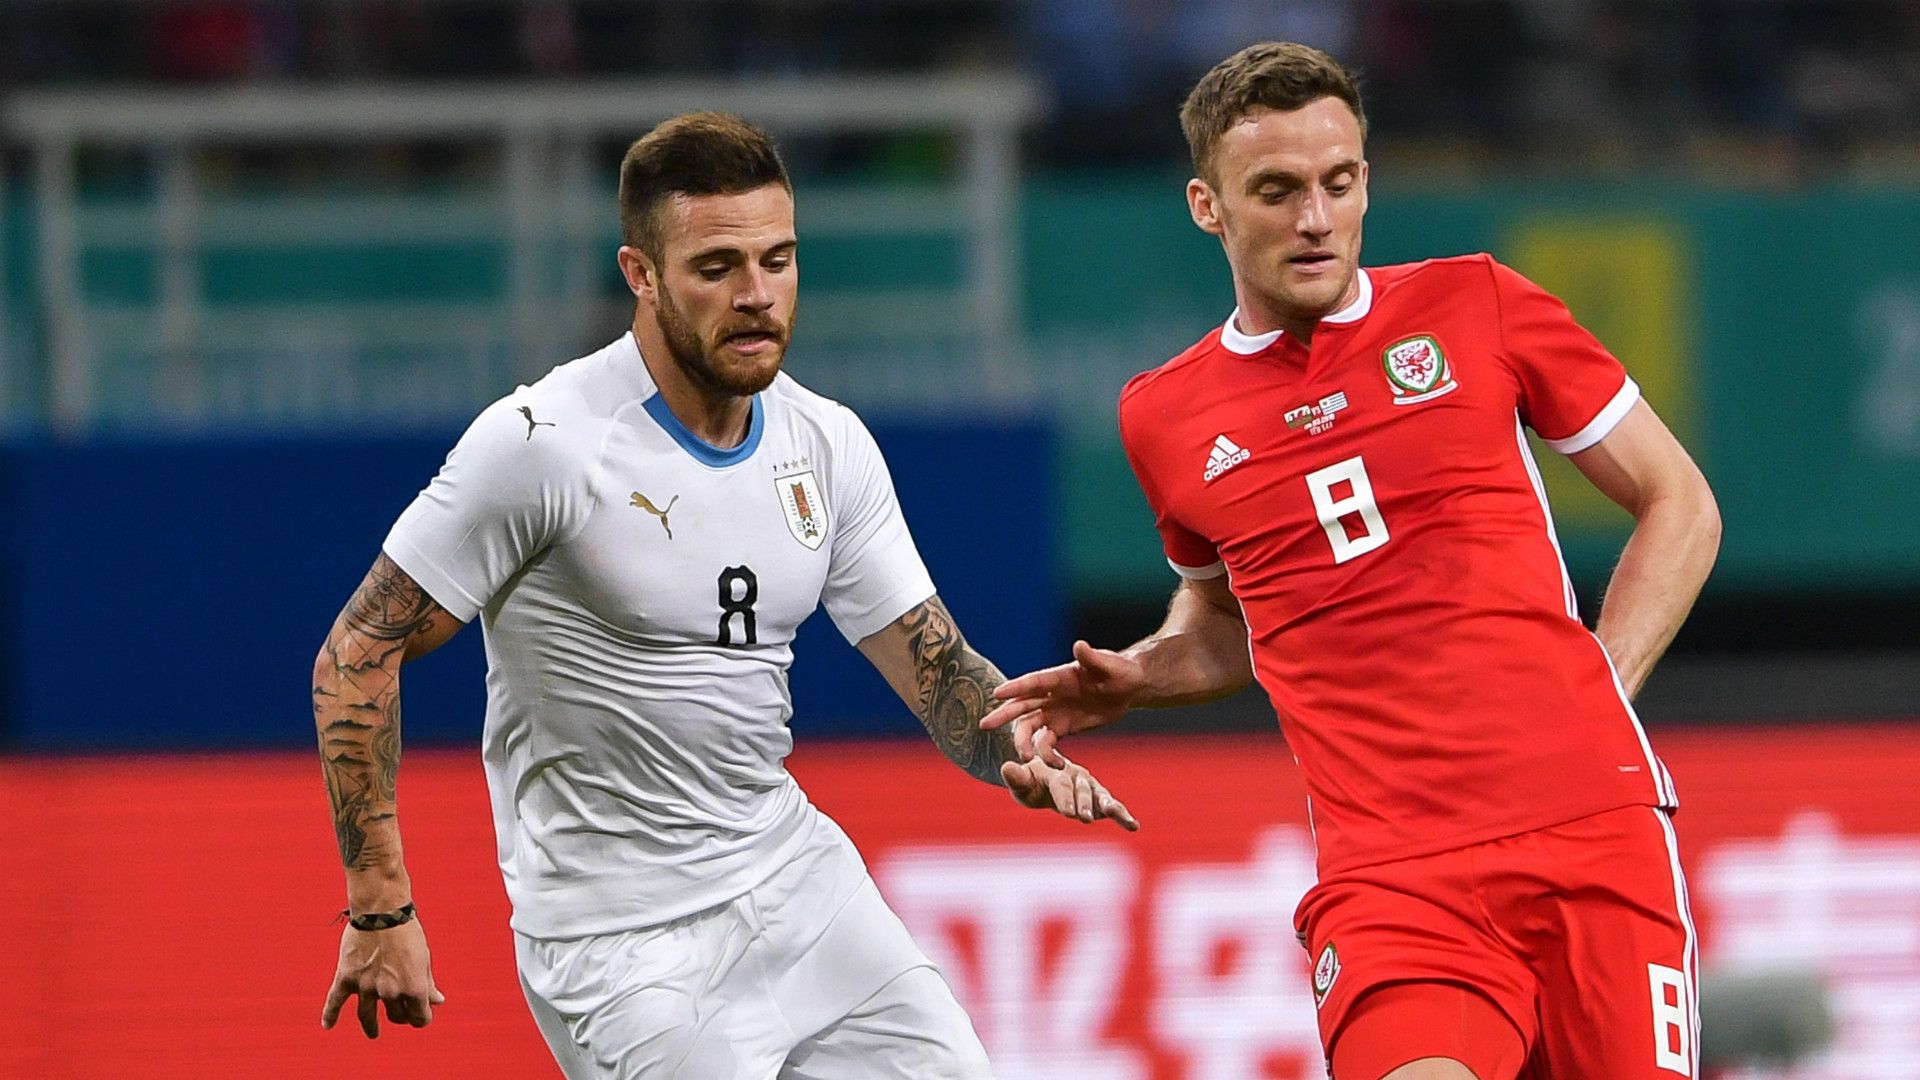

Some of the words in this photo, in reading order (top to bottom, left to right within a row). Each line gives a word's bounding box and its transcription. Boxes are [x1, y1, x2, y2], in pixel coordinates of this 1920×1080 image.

[1203, 449, 1251, 481] adidas
[1305, 456, 1390, 564] 8
[718, 565, 758, 645] 8
[1648, 963, 1691, 1077] 8
